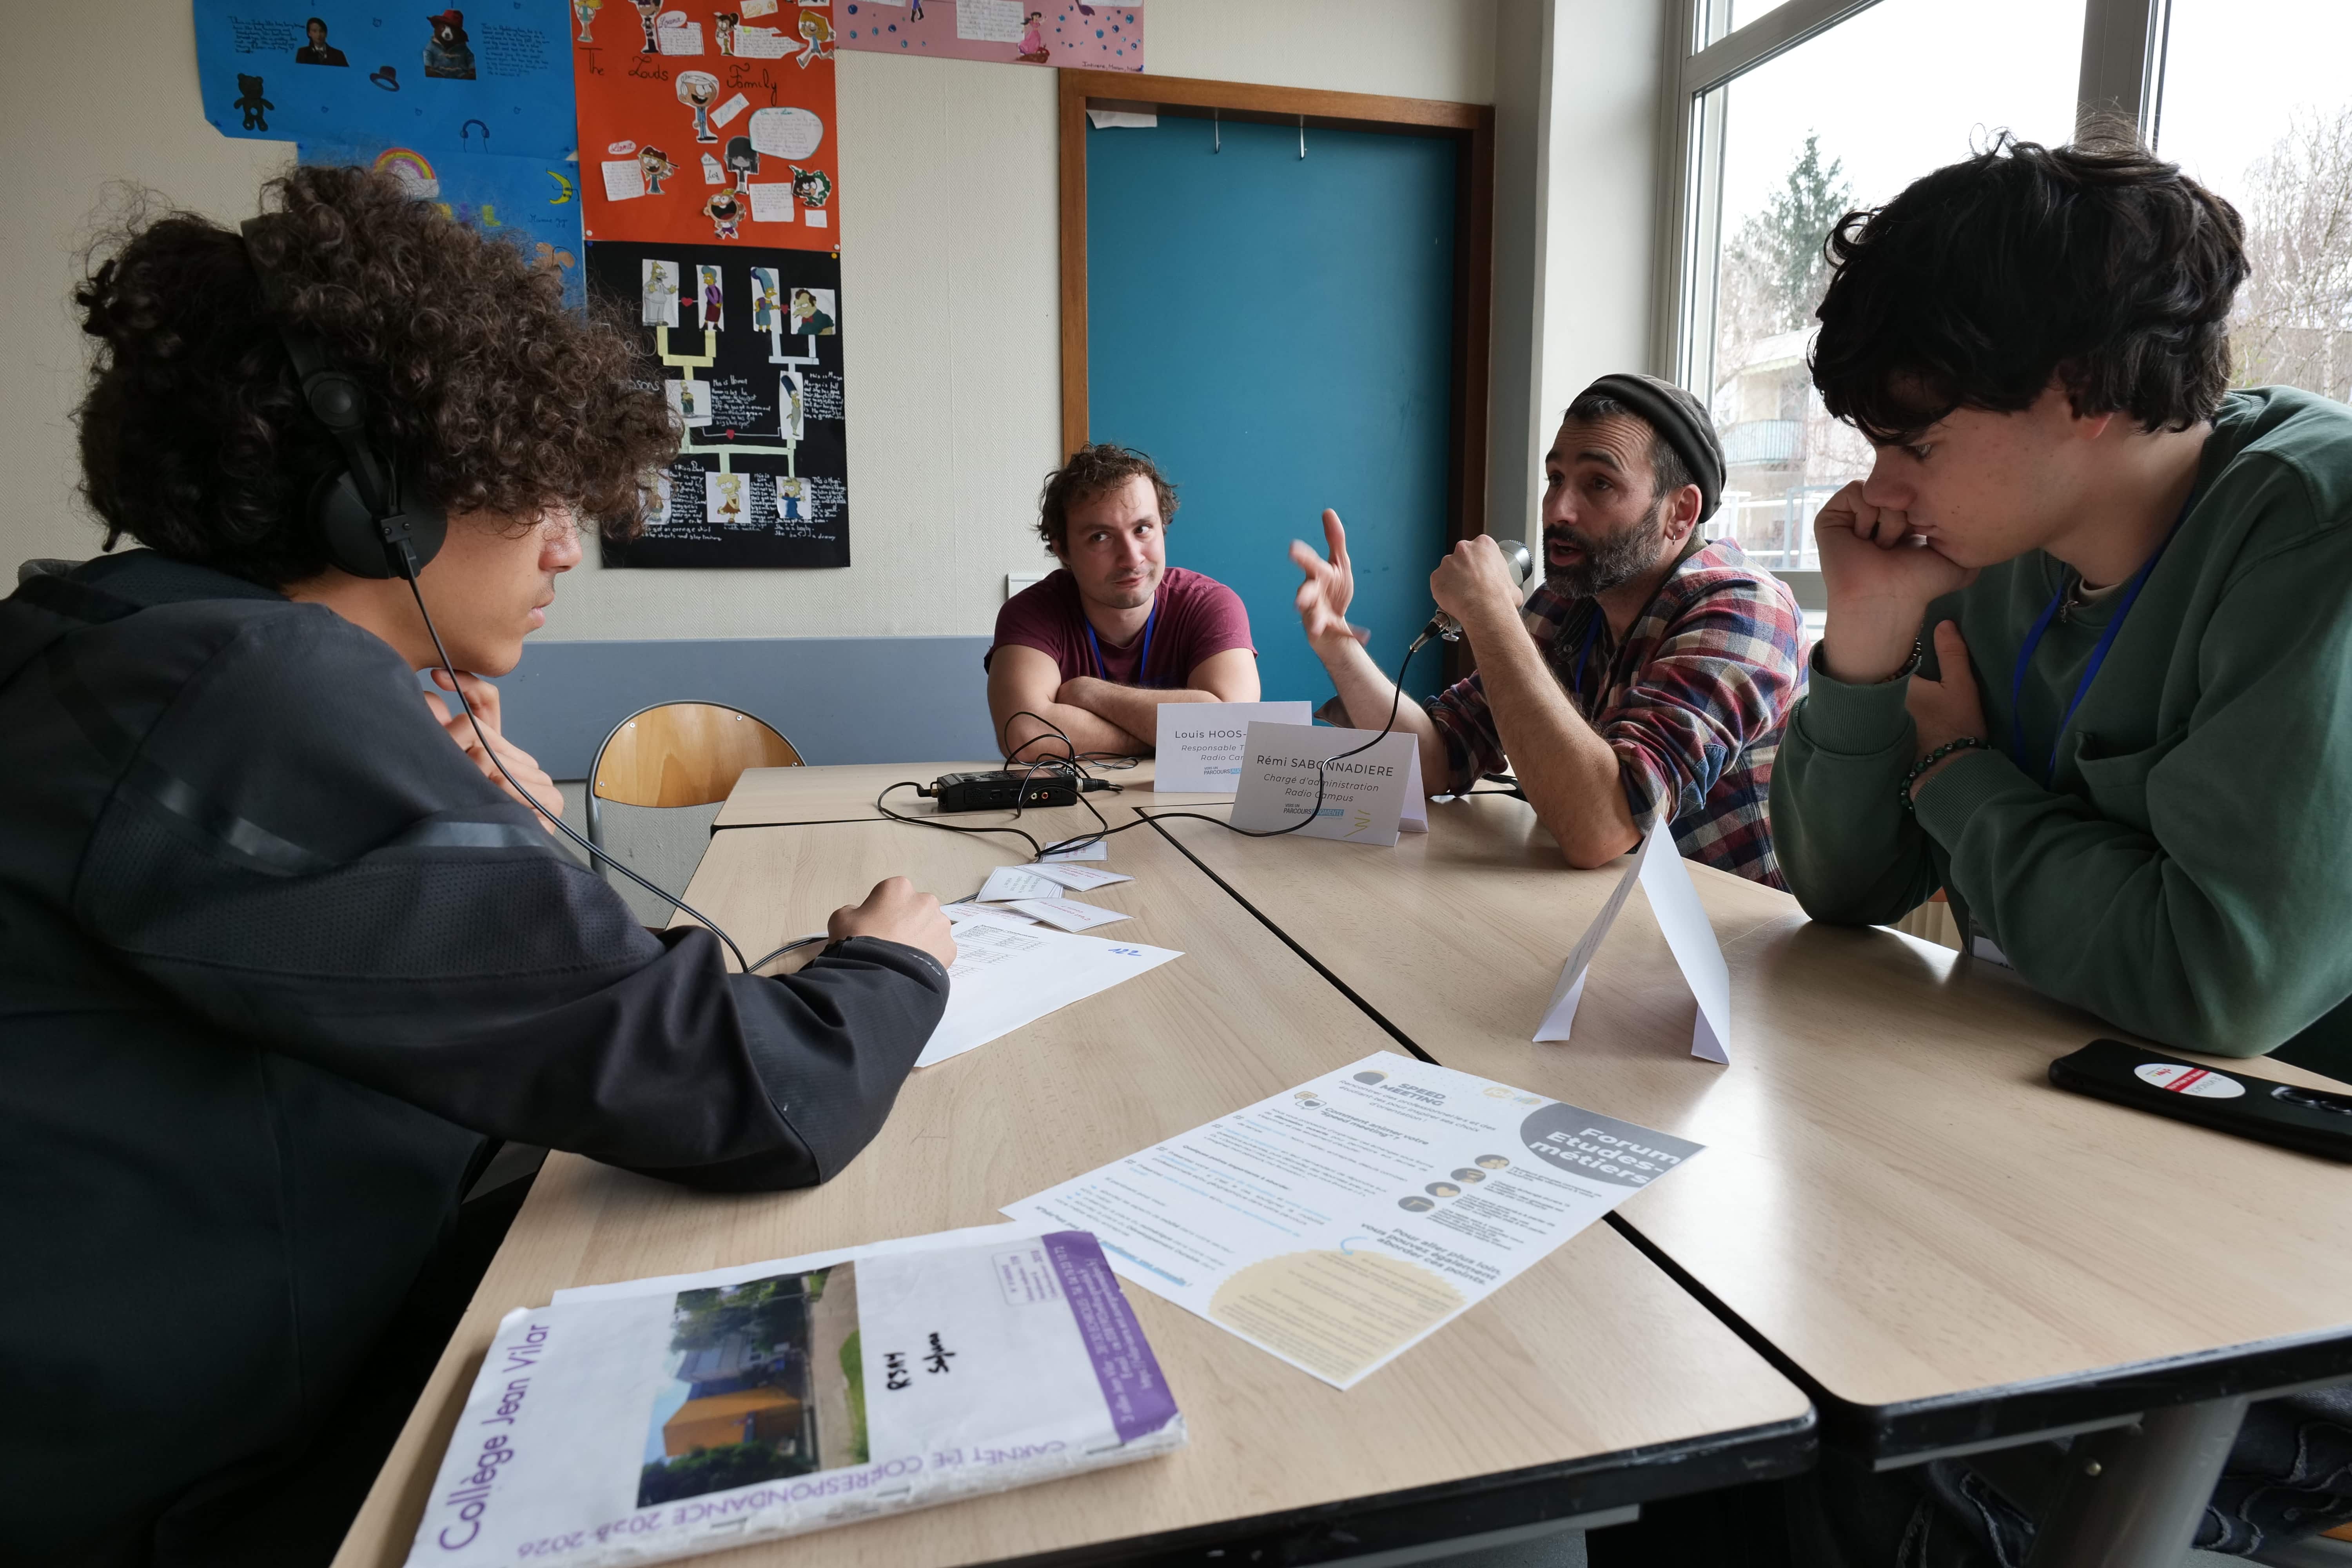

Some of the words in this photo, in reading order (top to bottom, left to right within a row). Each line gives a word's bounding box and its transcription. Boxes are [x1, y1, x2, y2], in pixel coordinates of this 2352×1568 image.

[579, 47, 604, 76] The
[726, 62, 778, 106] Family
[1256, 755, 1287, 767] Rémi
[1264, 773, 1297, 784] Chargé
[1299, 777, 1379, 792] d'administration
[1285, 788, 1312, 798] Radio
[1315, 791, 1354, 802] Campus
[1108, 948, 1142, 956] 122
[1338, 1080, 1383, 1095] Rencontrer
[1379, 1084, 1445, 1106] MEETING
[1397, 1083, 1447, 1100] SPEED
[1323, 1107, 1370, 1124] Comment
[1368, 1123, 1404, 1136] animer
[1401, 1134, 1430, 1145] votre
[1368, 1102, 1423, 1121] d'orientation
[1385, 1101, 1408, 1109] pour
[1406, 1107, 1441, 1120] inspirer
[1454, 1123, 1481, 1132] choix
[1547, 1132, 1669, 1173] Etudes-
[1579, 1128, 1684, 1163] Forum
[1530, 1140, 1653, 1183] métiers
[1360, 1223, 1387, 1236] vous
[1385, 1234, 1430, 1254] pouvez
[1429, 1252, 1497, 1281] également
[1376, 1238, 1424, 1258] aborder
[1423, 1257, 1445, 1267] ces
[1391, 1229, 1422, 1242] Pour
[1420, 1240, 1450, 1253] aller
[1446, 1251, 1477, 1264] plus
[503, 1323, 551, 1373] Vilar
[1100, 1360, 1118, 1378] Vilar
[1109, 1377, 1125, 1394] Jean
[481, 1378, 529, 1427] Jean
[971, 1440, 1068, 1467] CARNET
[438, 1436, 511, 1552] Collège
